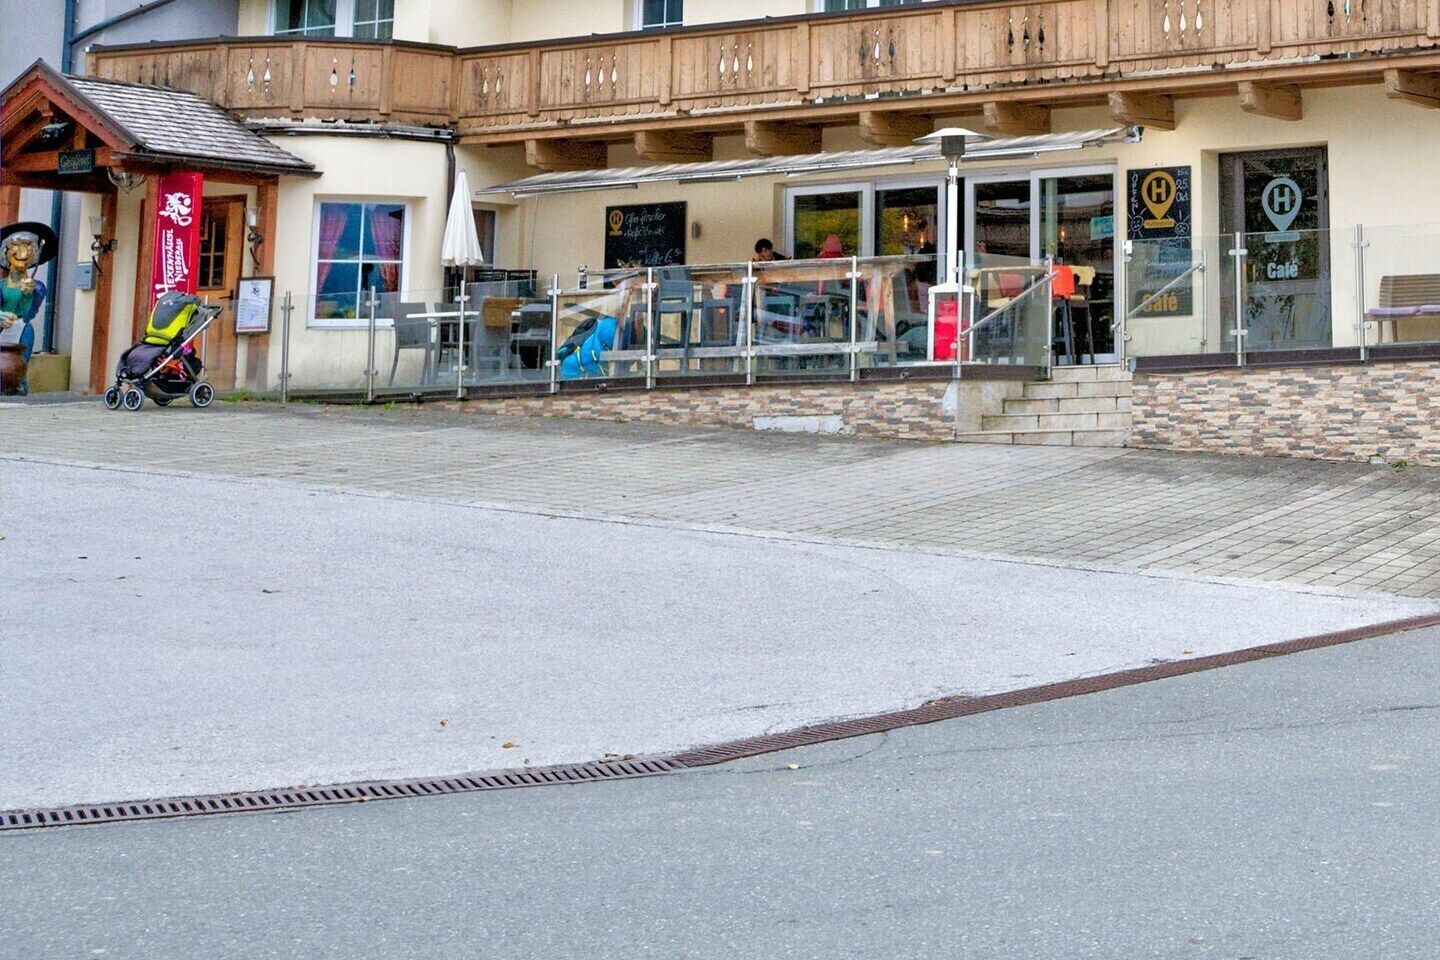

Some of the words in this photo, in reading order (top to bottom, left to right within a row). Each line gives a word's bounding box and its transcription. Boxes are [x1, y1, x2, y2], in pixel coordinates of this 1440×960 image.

[1151, 180, 1167, 202] H
[1273, 187, 1291, 212] H
[174, 238, 187, 281] NIEDERAU
[1267, 260, 1298, 279] Café
[1142, 292, 1178, 313] Café
